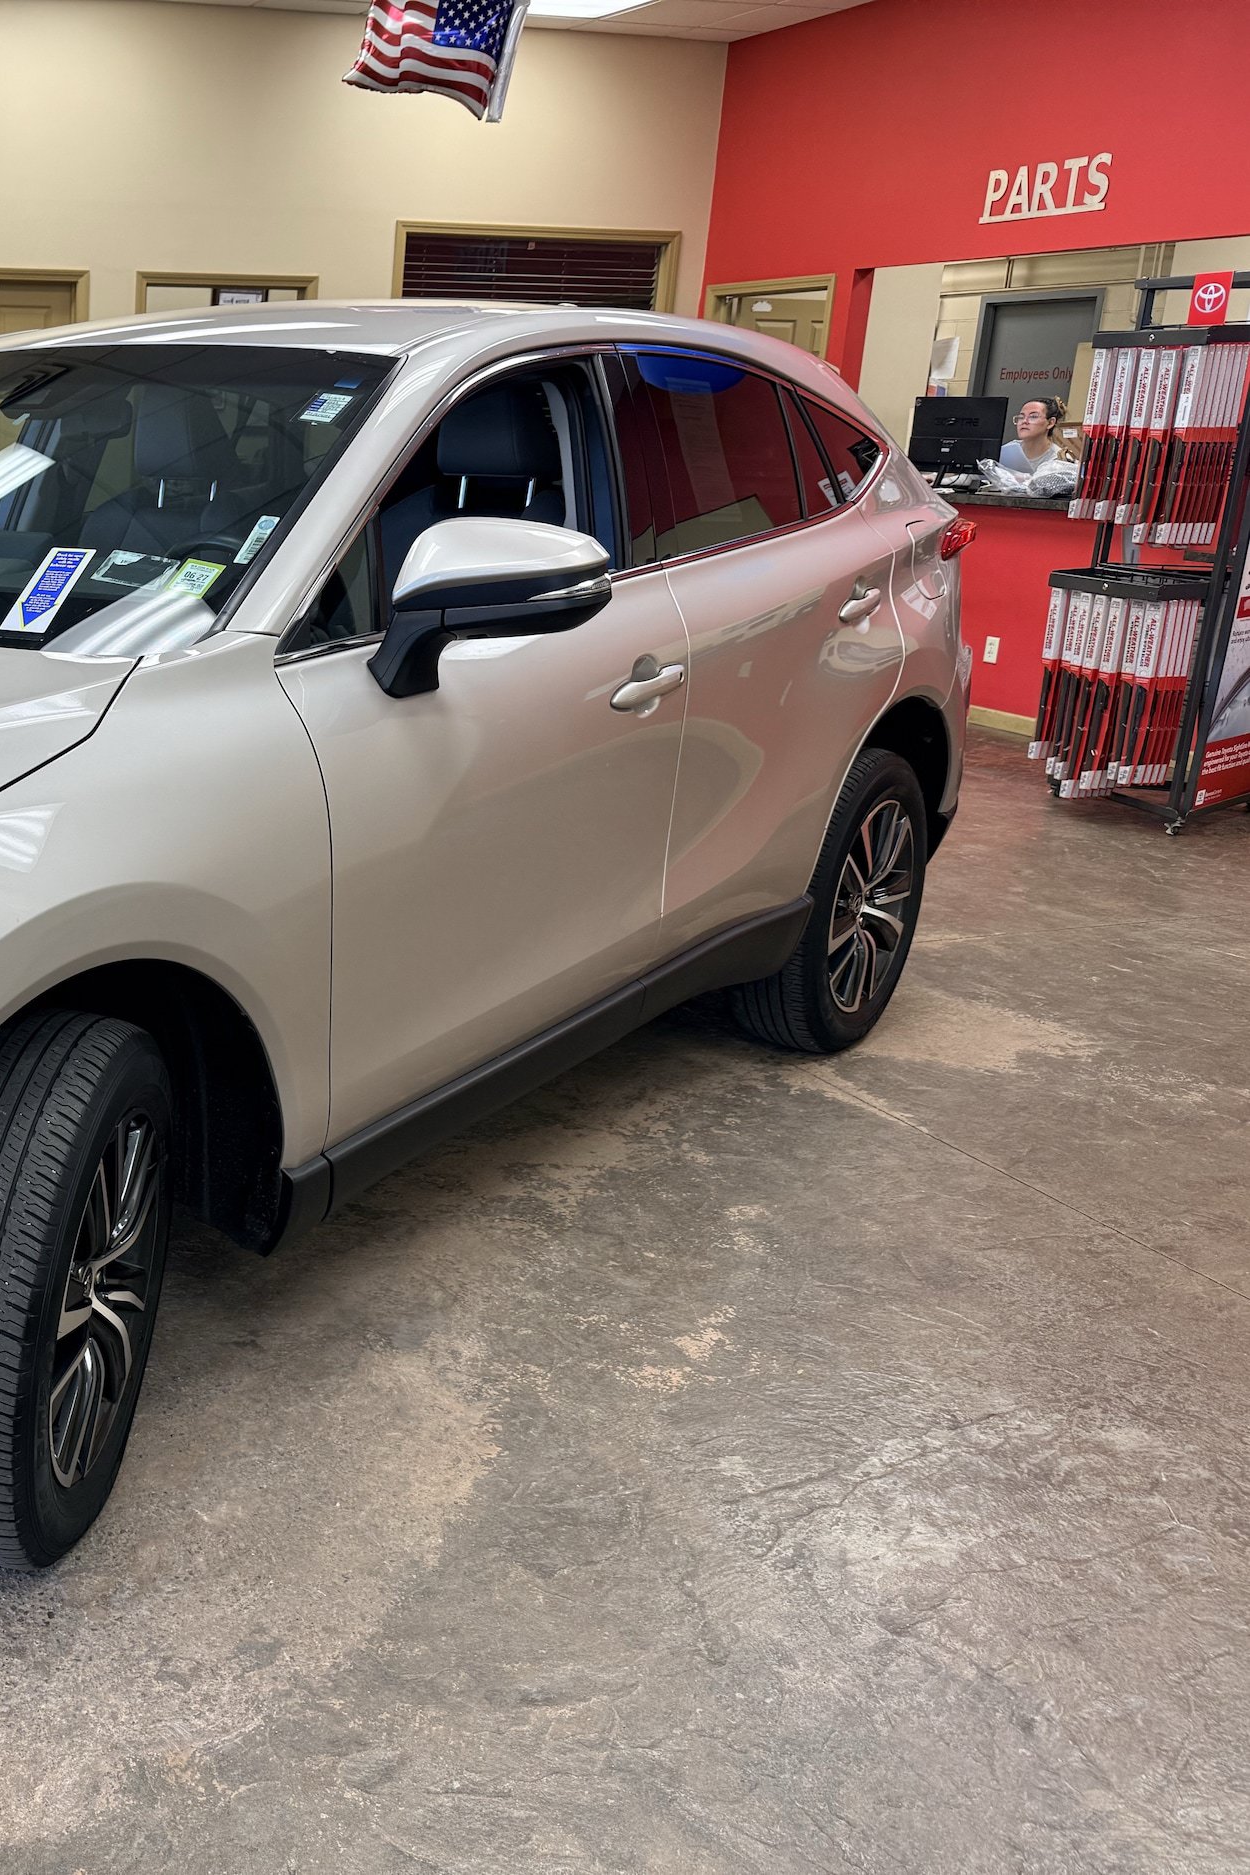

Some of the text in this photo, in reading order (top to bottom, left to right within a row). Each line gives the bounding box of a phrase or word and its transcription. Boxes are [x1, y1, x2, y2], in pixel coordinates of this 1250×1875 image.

[981, 152, 1113, 221] PARTS
[1000, 367, 1072, 384] Employees Only
[1137, 367, 1149, 418] ALL-WEATHER
[1158, 368, 1170, 418] ALL-WEATHER
[1129, 615, 1140, 663] ALL-WEATHER
[1144, 619, 1156, 667] ALL-WEATHER
